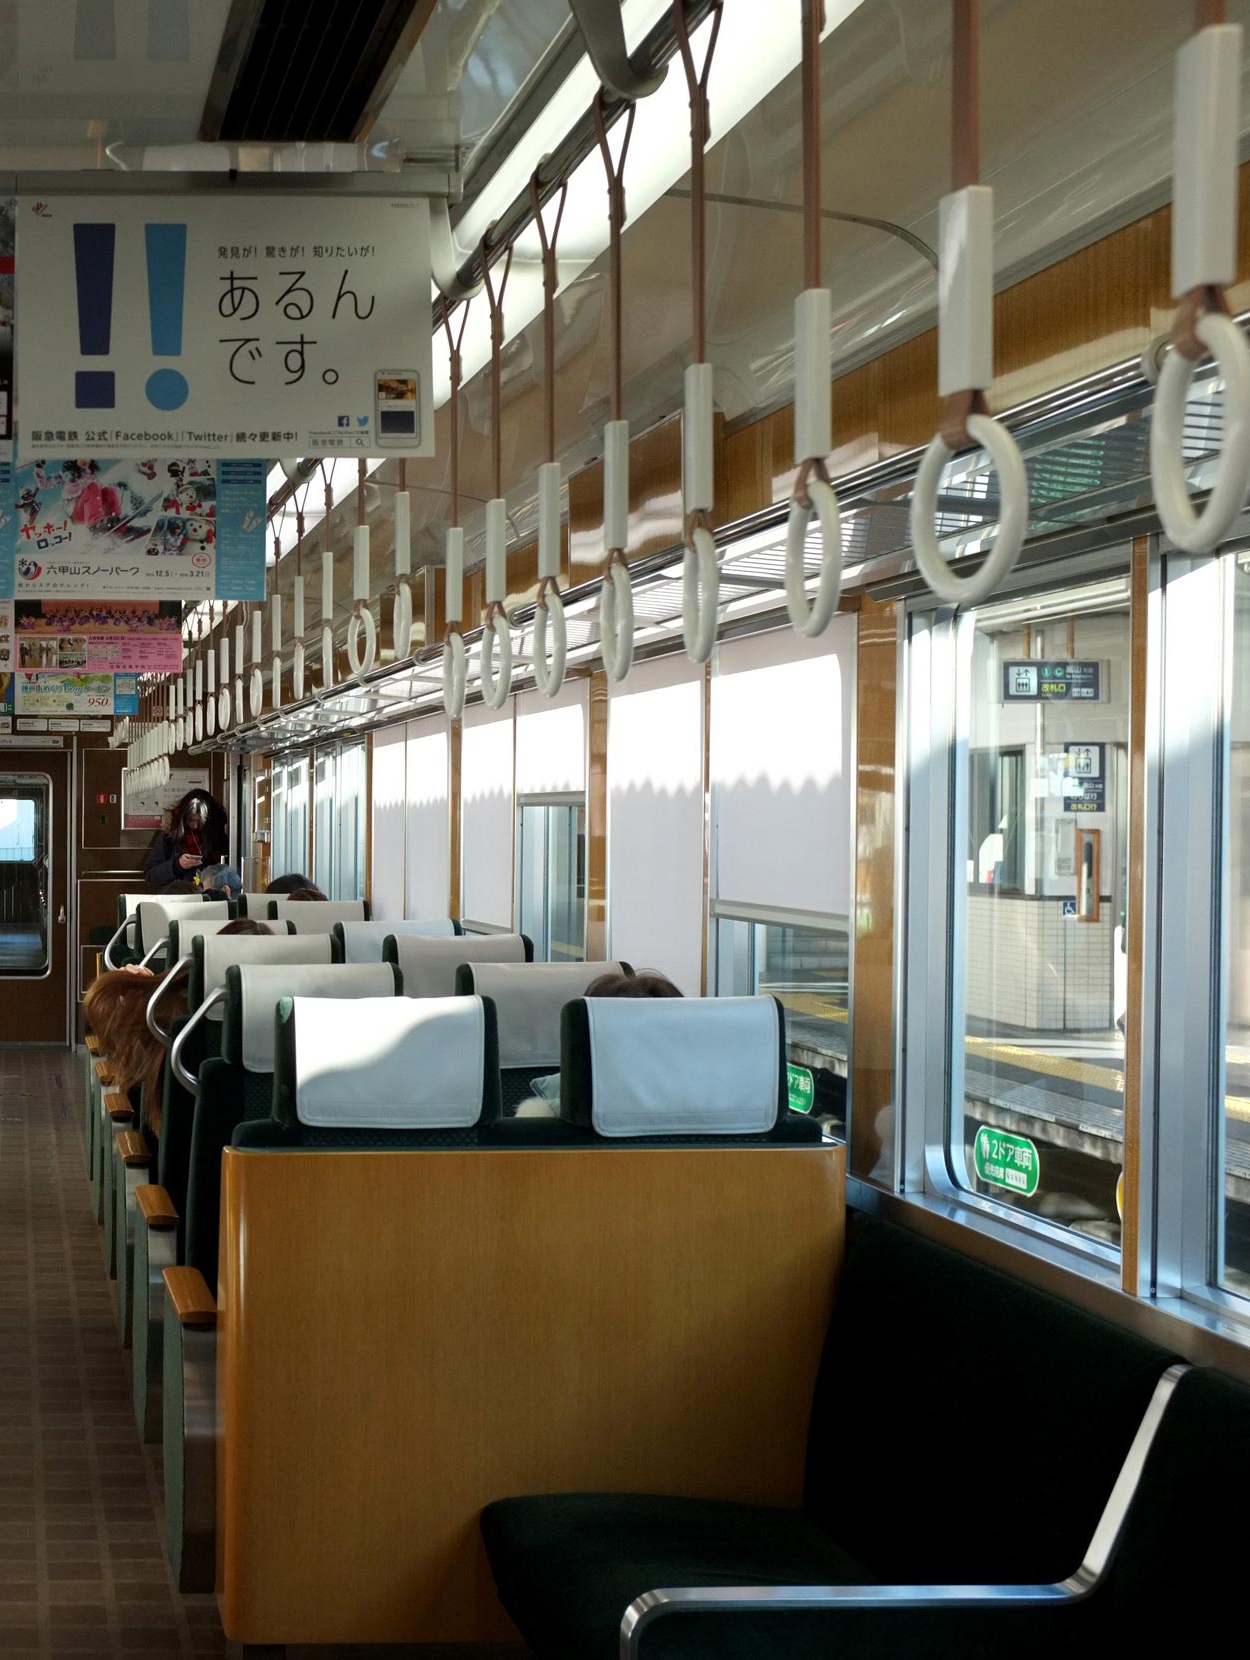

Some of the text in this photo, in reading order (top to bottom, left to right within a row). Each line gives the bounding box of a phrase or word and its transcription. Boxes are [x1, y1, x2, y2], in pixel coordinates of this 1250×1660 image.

[217, 245, 376, 259] 発見が! 驚きが! 知りたいが!
[218, 269, 376, 321] あるん
[218, 333, 340, 385] です。
[31, 430, 79, 442] 阪急電鉄
[46, 564, 140, 576] 六甲山スノーパーク
[787, 1072, 811, 1094] ドア車両
[992, 1139, 1033, 1171] 2ドア車両
